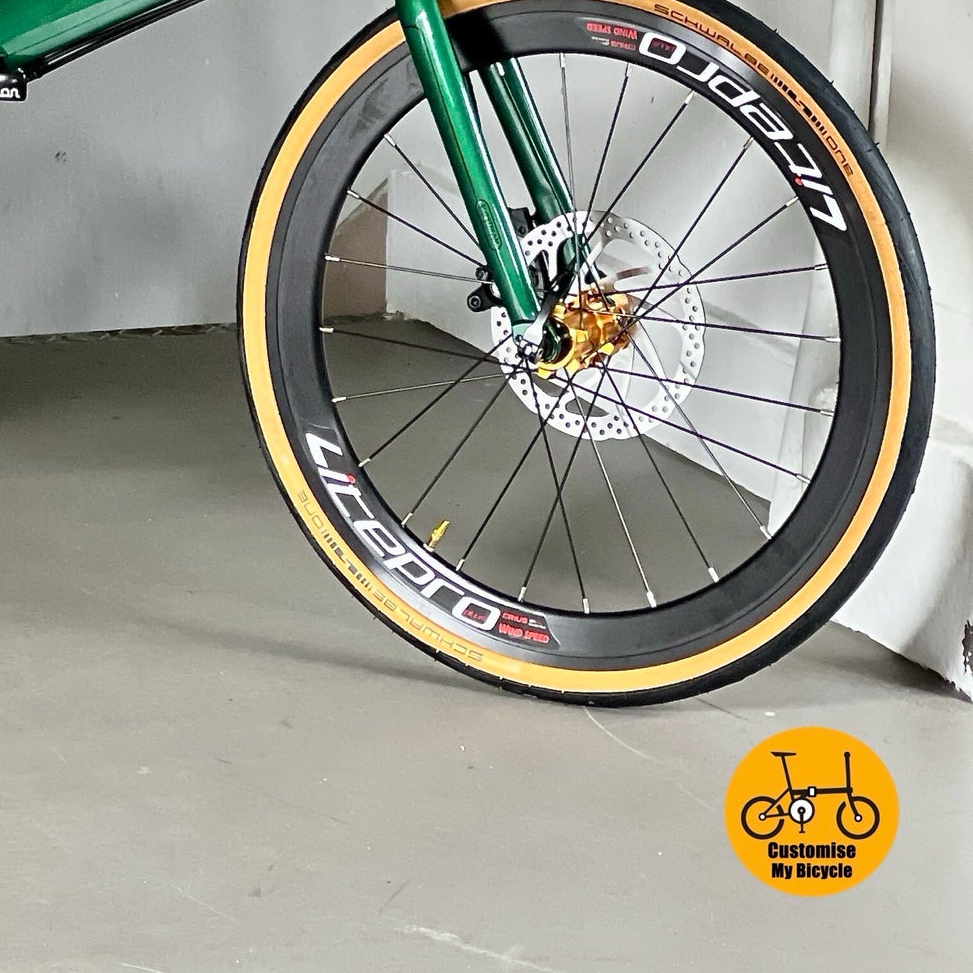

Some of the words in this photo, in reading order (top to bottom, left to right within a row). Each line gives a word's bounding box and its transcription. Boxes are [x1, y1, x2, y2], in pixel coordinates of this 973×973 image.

[653, 4, 769, 75] SCHWALBE
[638, 31, 848, 232] Litepro
[305, 432, 500, 632] Litepro
[373, 591, 483, 662] SCHWALBE
